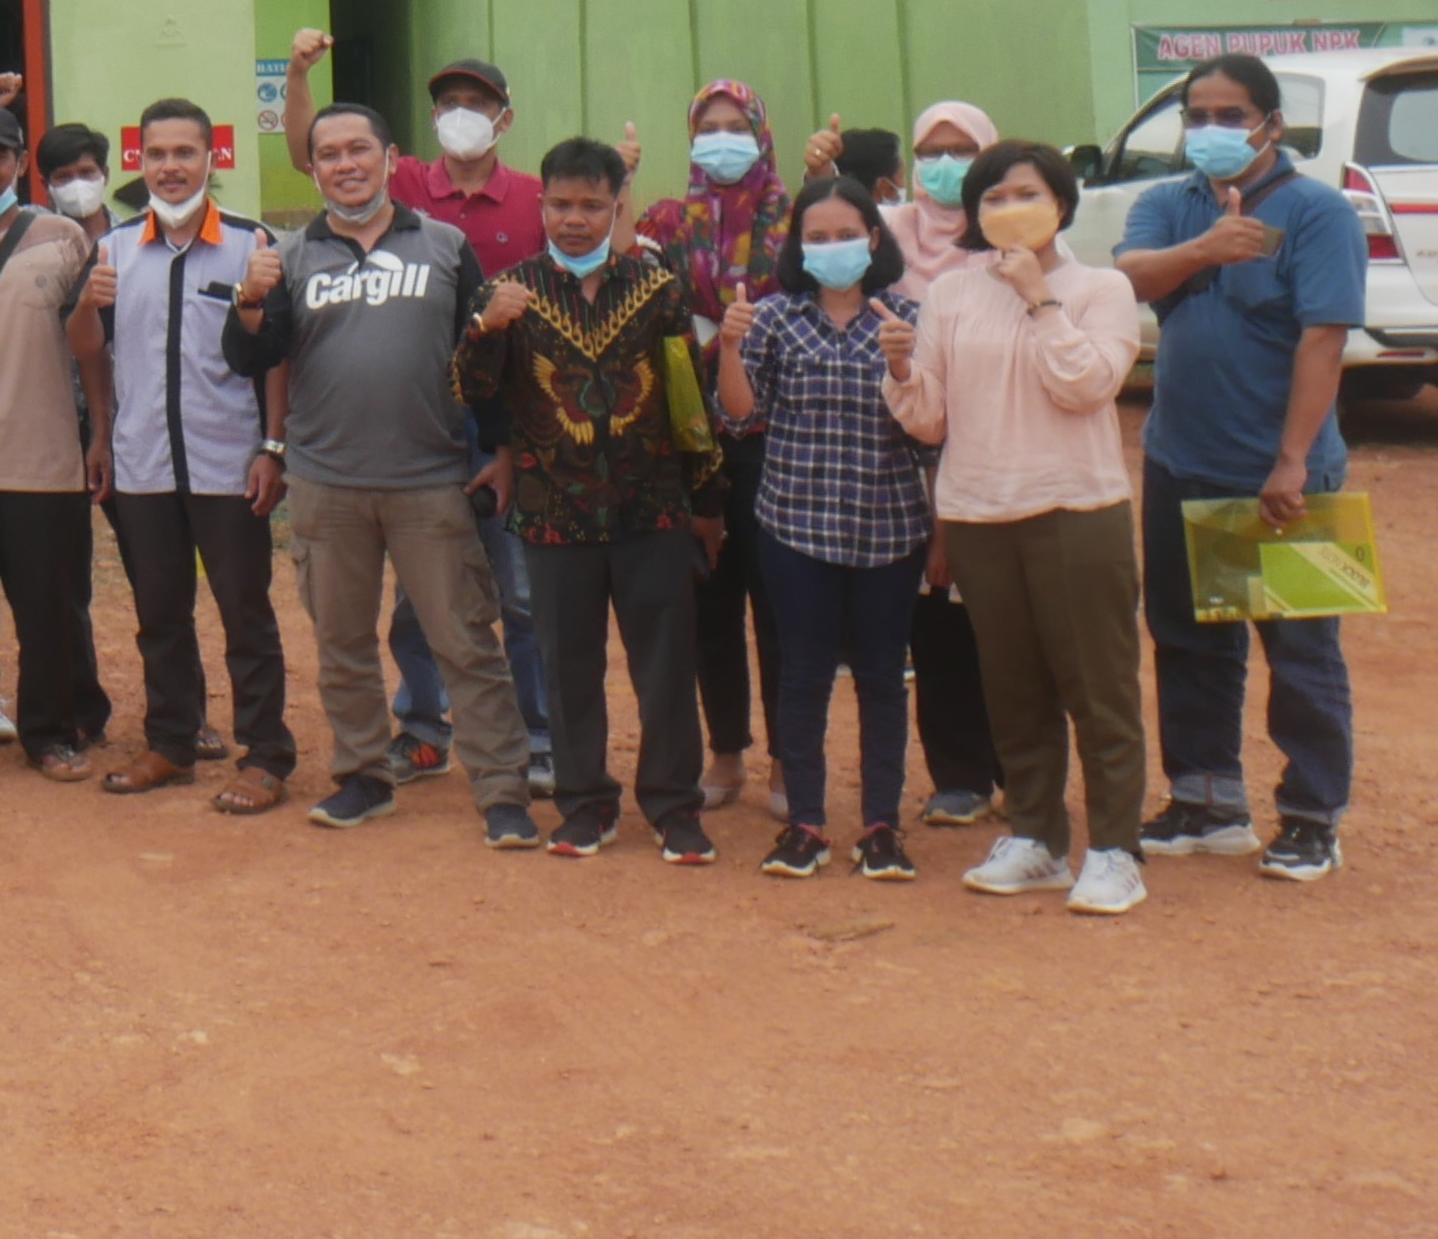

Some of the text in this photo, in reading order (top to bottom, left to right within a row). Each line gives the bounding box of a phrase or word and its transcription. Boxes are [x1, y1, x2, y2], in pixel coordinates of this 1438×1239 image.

[1157, 29, 1361, 61] AGEN PUPUK NPK
[306, 263, 431, 310] Cargill
